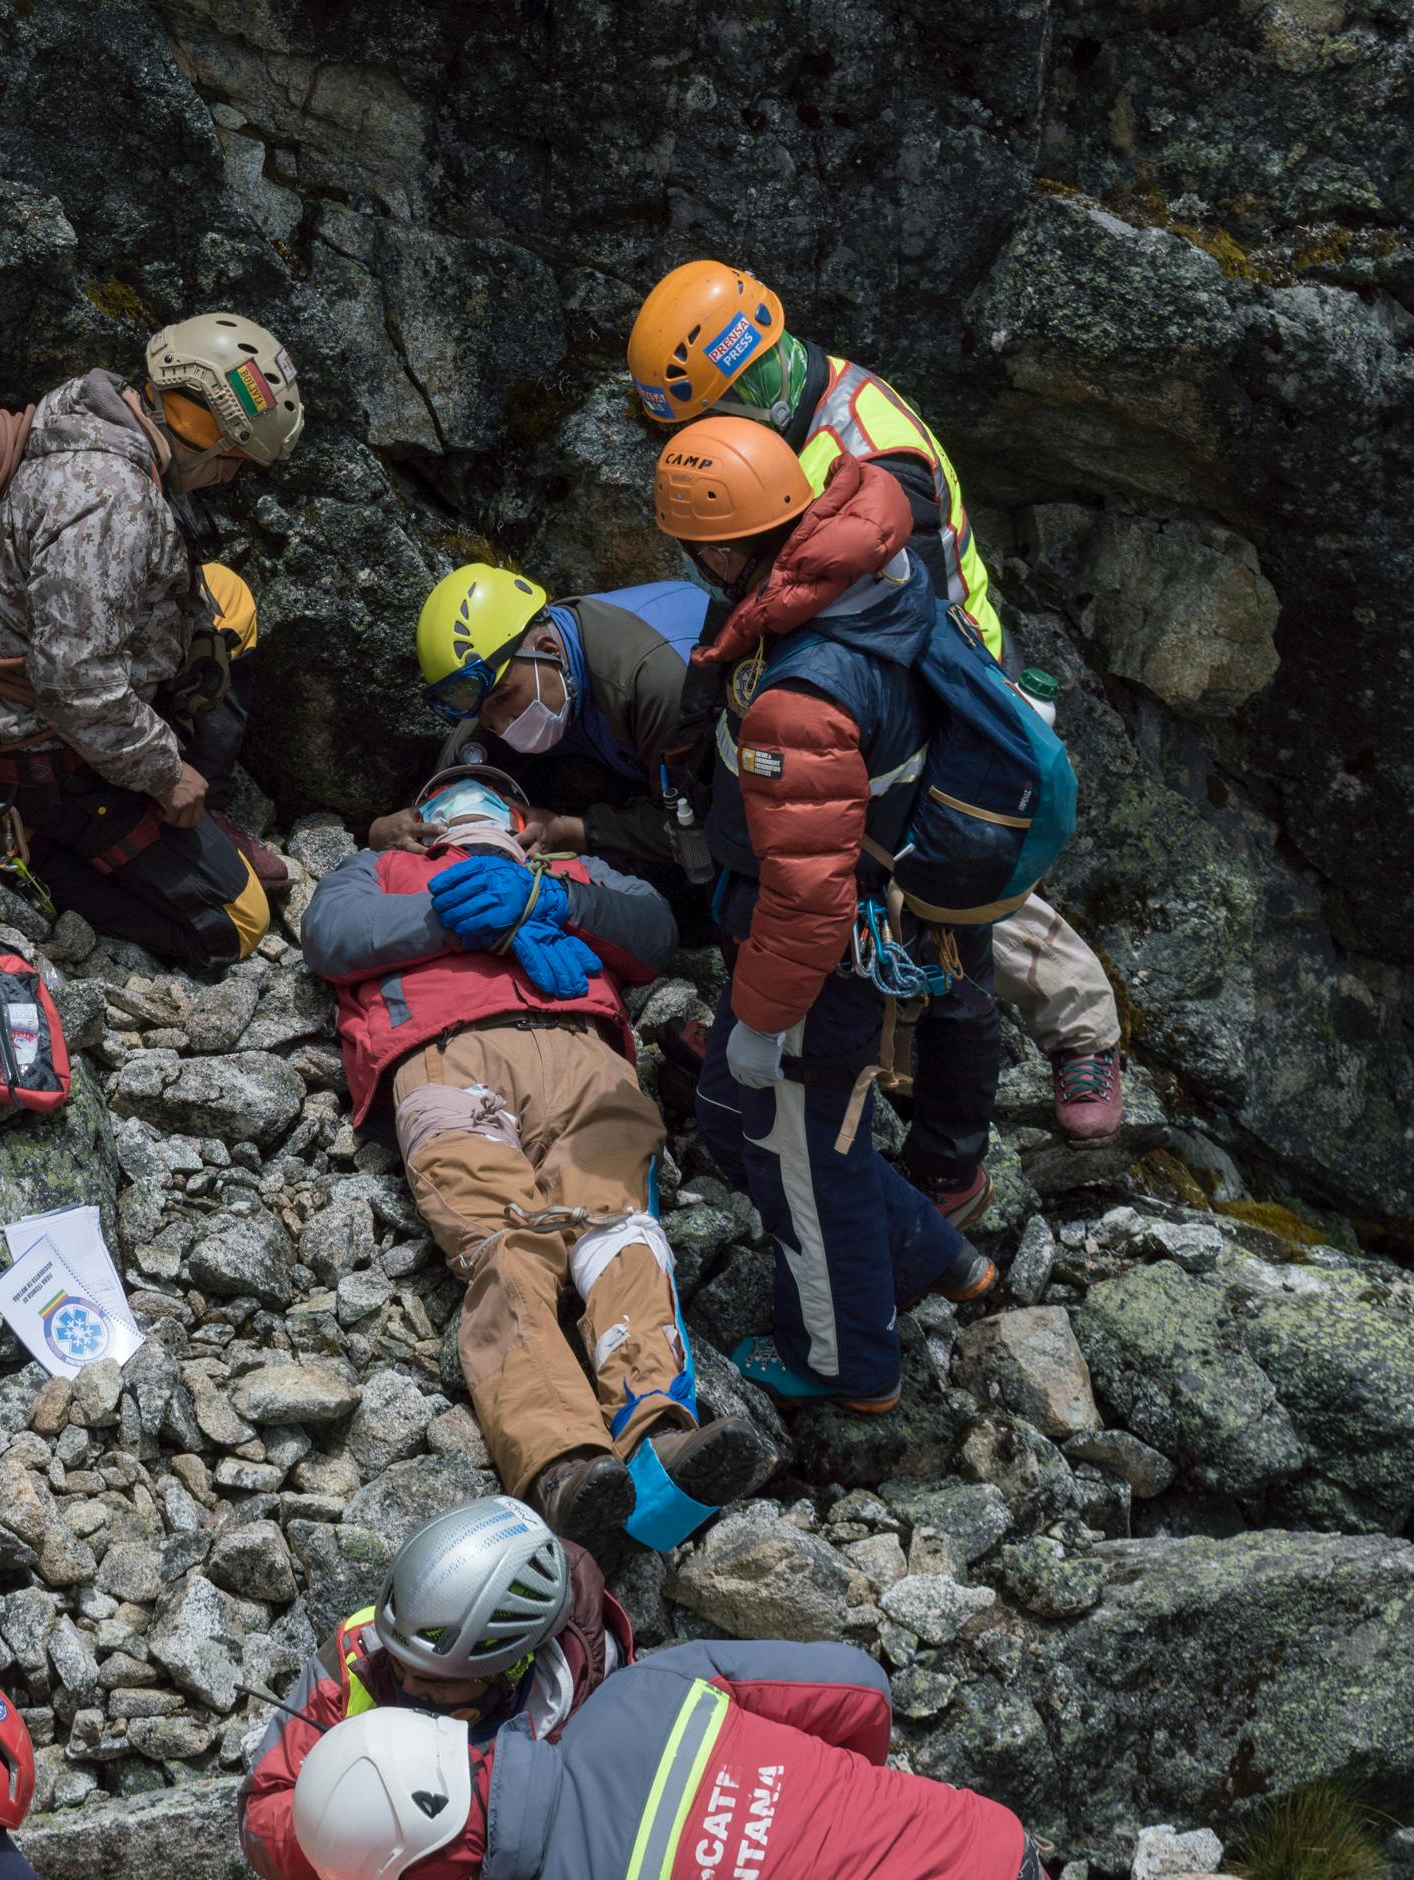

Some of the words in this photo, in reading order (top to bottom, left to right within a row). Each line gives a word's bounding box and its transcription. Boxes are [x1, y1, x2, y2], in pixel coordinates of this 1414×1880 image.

[710, 318, 750, 363] PRENSA
[724, 331, 753, 367] PRESS
[241, 369, 264, 406] BOLIVIA
[665, 452, 714, 470] CAMP
